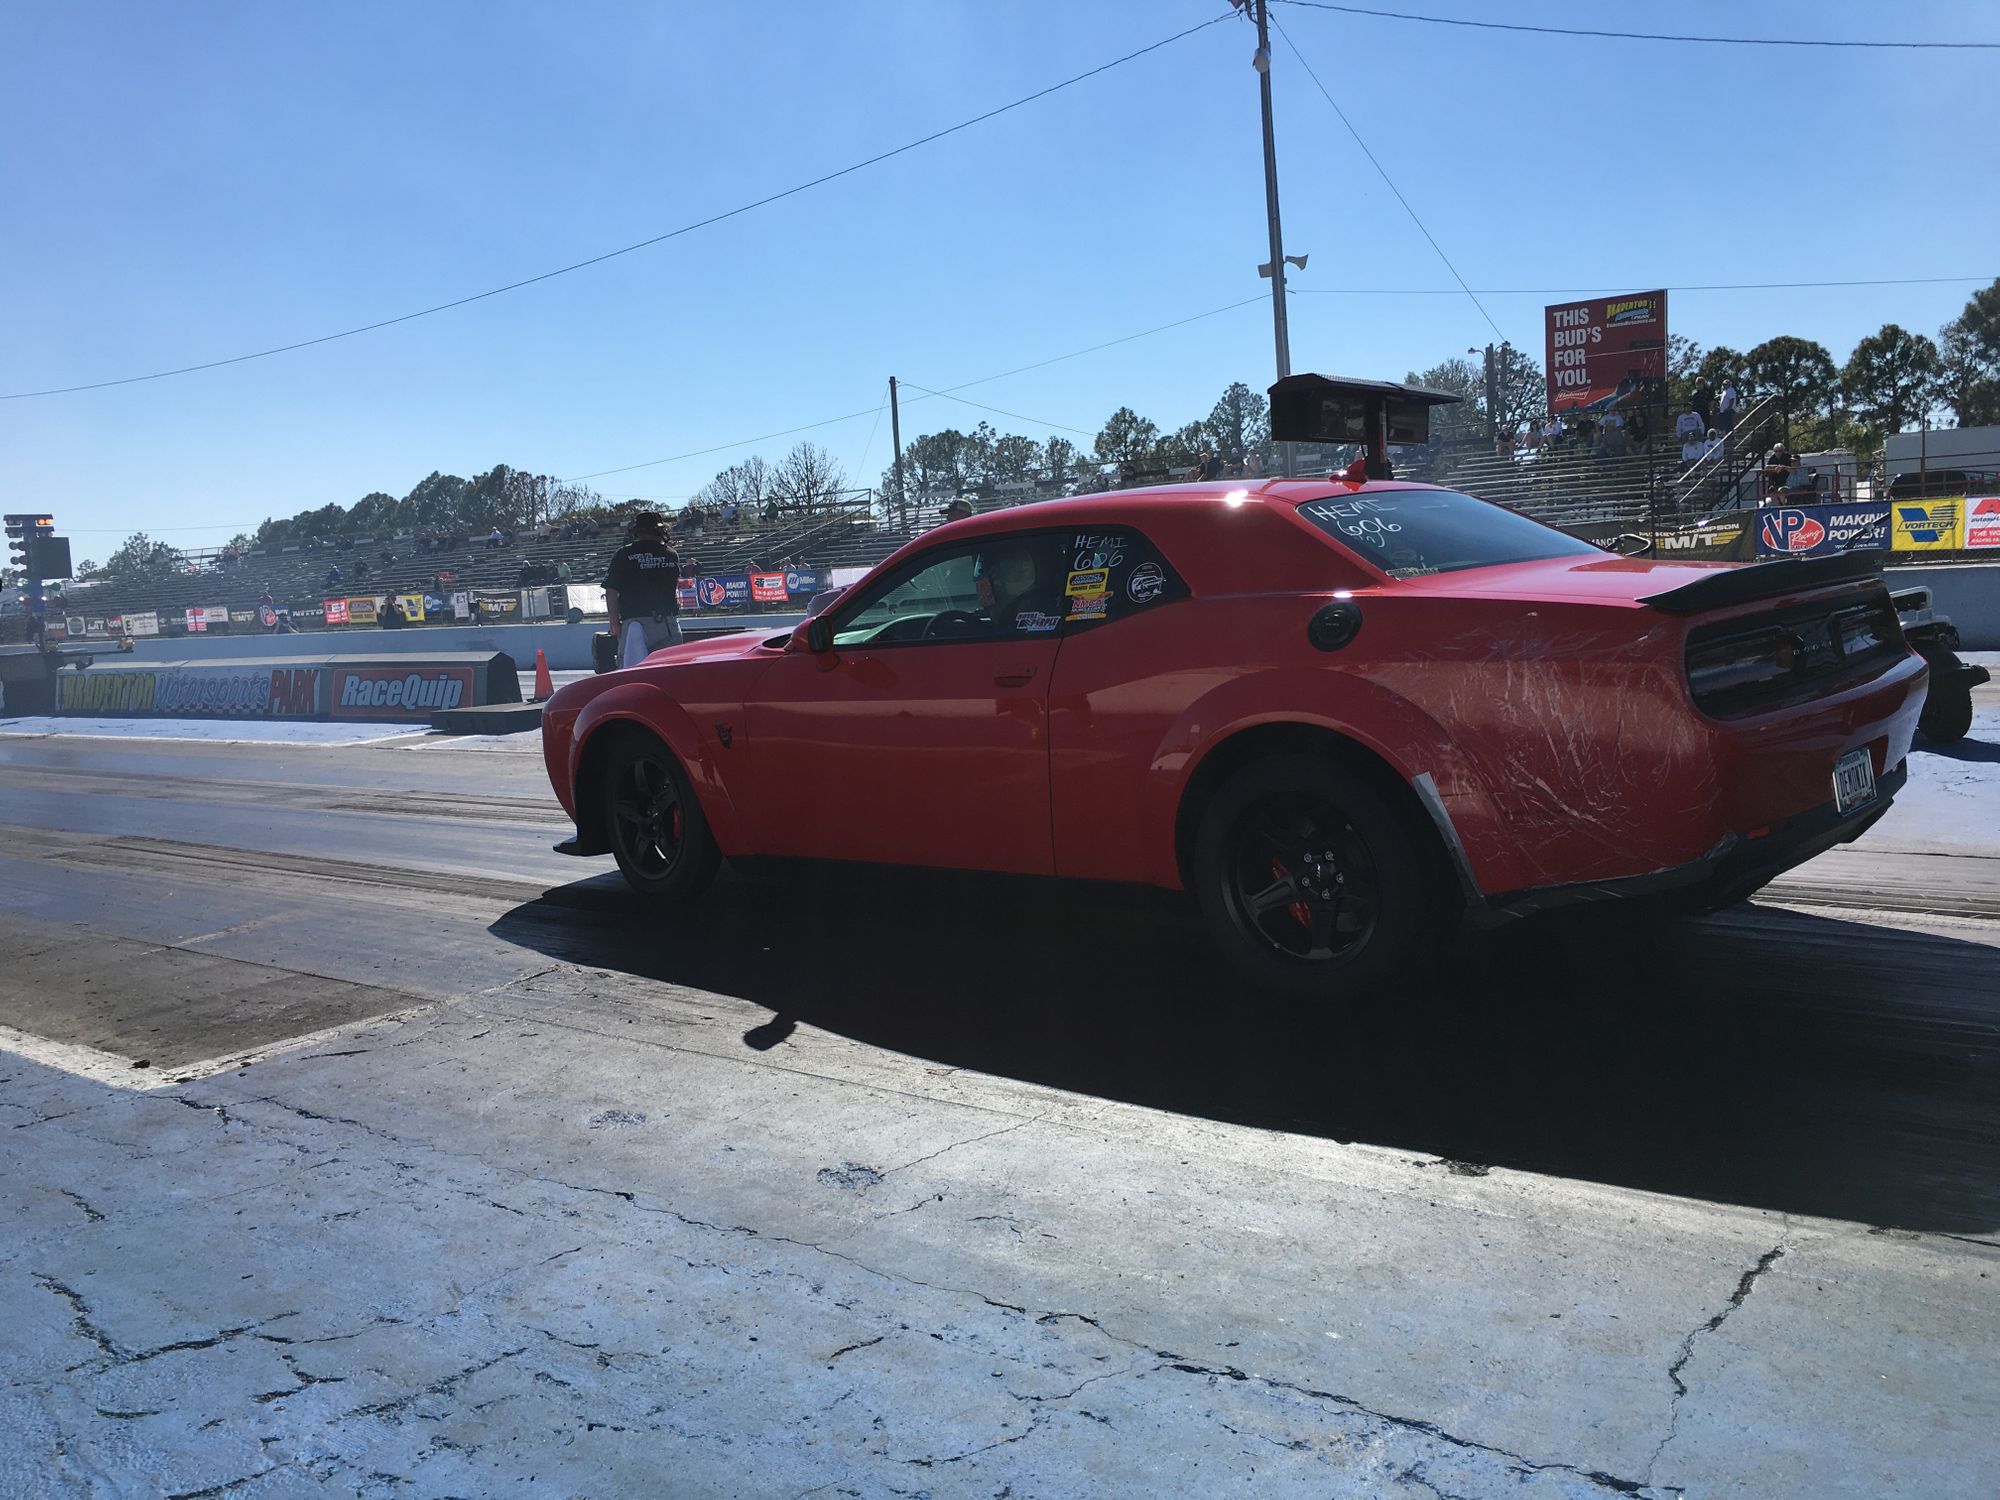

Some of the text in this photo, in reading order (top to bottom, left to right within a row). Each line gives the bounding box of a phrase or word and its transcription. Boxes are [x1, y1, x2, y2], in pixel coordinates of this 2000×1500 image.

[1553, 307, 1589, 328] THIS
[1554, 326, 1601, 348] BUD'S
[1554, 348, 1586, 368] FOR
[1554, 368, 1591, 387] YOU.
[1307, 499, 1397, 521] HEMI
[1337, 517, 1402, 536] 606
[1676, 523, 1740, 535] THOMPSON
[1763, 509, 1806, 552] VP
[1904, 521, 1953, 530] VORTECH
[1074, 535, 1129, 549] HEMI
[1664, 533, 1718, 550] M/T
[1791, 529, 1822, 546] Racing
[1074, 550, 1124, 571] 606
[292, 608, 324, 617] NITTO
[62, 673, 156, 711] BRADENTON
[268, 669, 319, 714] PARK
[340, 673, 464, 710] RaceQuip
